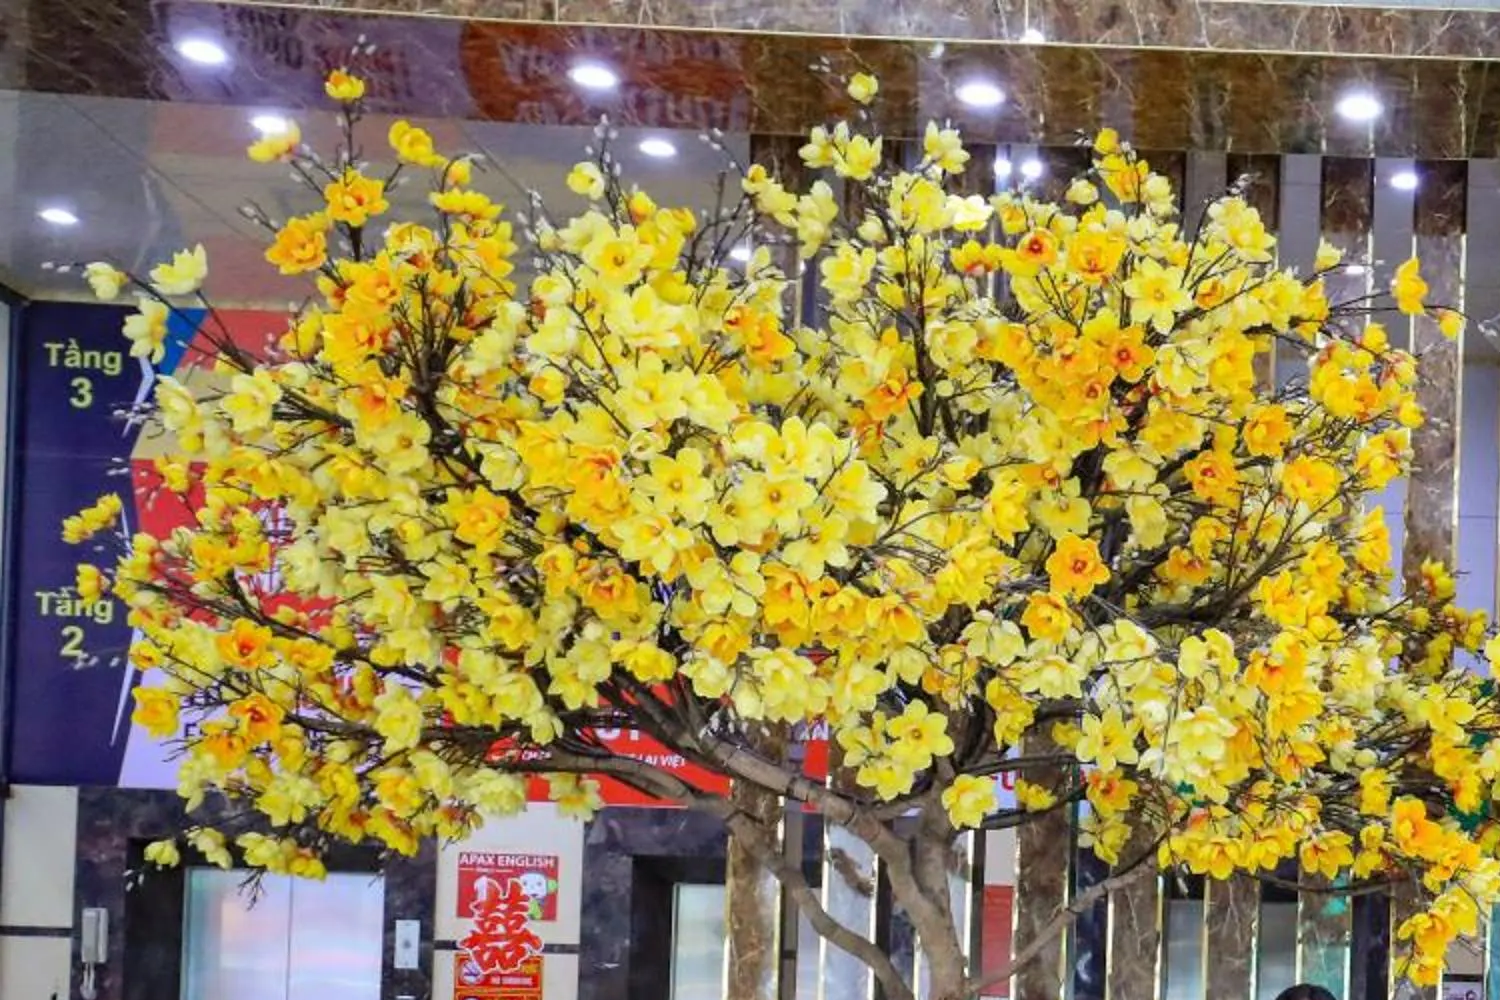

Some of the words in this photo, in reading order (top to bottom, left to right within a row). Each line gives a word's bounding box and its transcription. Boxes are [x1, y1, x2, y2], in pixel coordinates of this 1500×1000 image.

[44, 338, 122, 376] Tầng
[69, 377, 93, 409] 3
[60, 625, 85, 656] 2
[459, 853, 495, 866] APAX
[497, 855, 554, 868] ENGLISH
